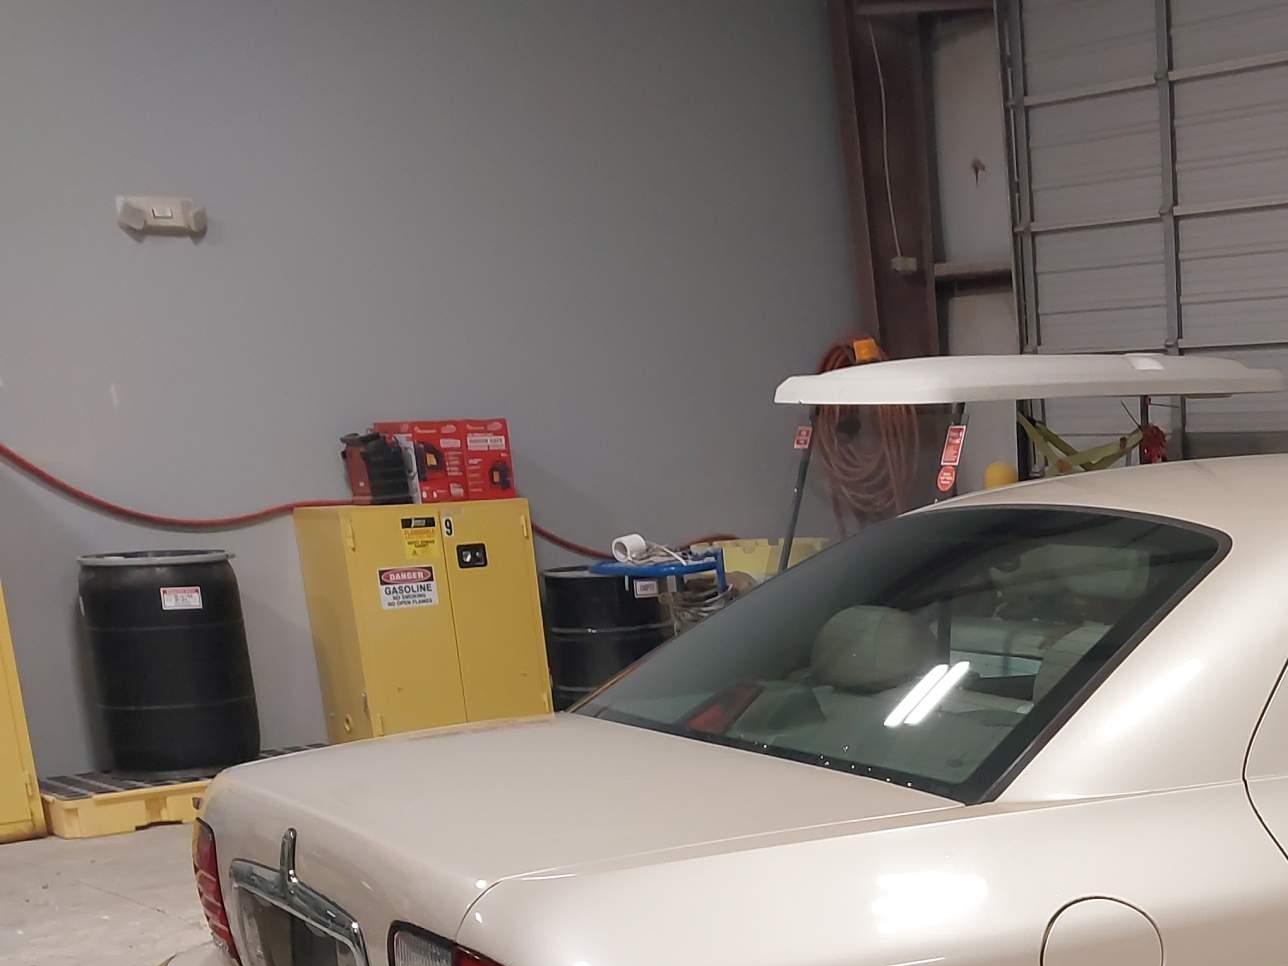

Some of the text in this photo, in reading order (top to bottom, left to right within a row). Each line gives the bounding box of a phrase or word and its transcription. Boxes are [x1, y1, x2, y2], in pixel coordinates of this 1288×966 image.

[444, 518, 453, 536] 9
[389, 571, 424, 581] DANGER
[384, 583, 433, 596] GASOLINE
